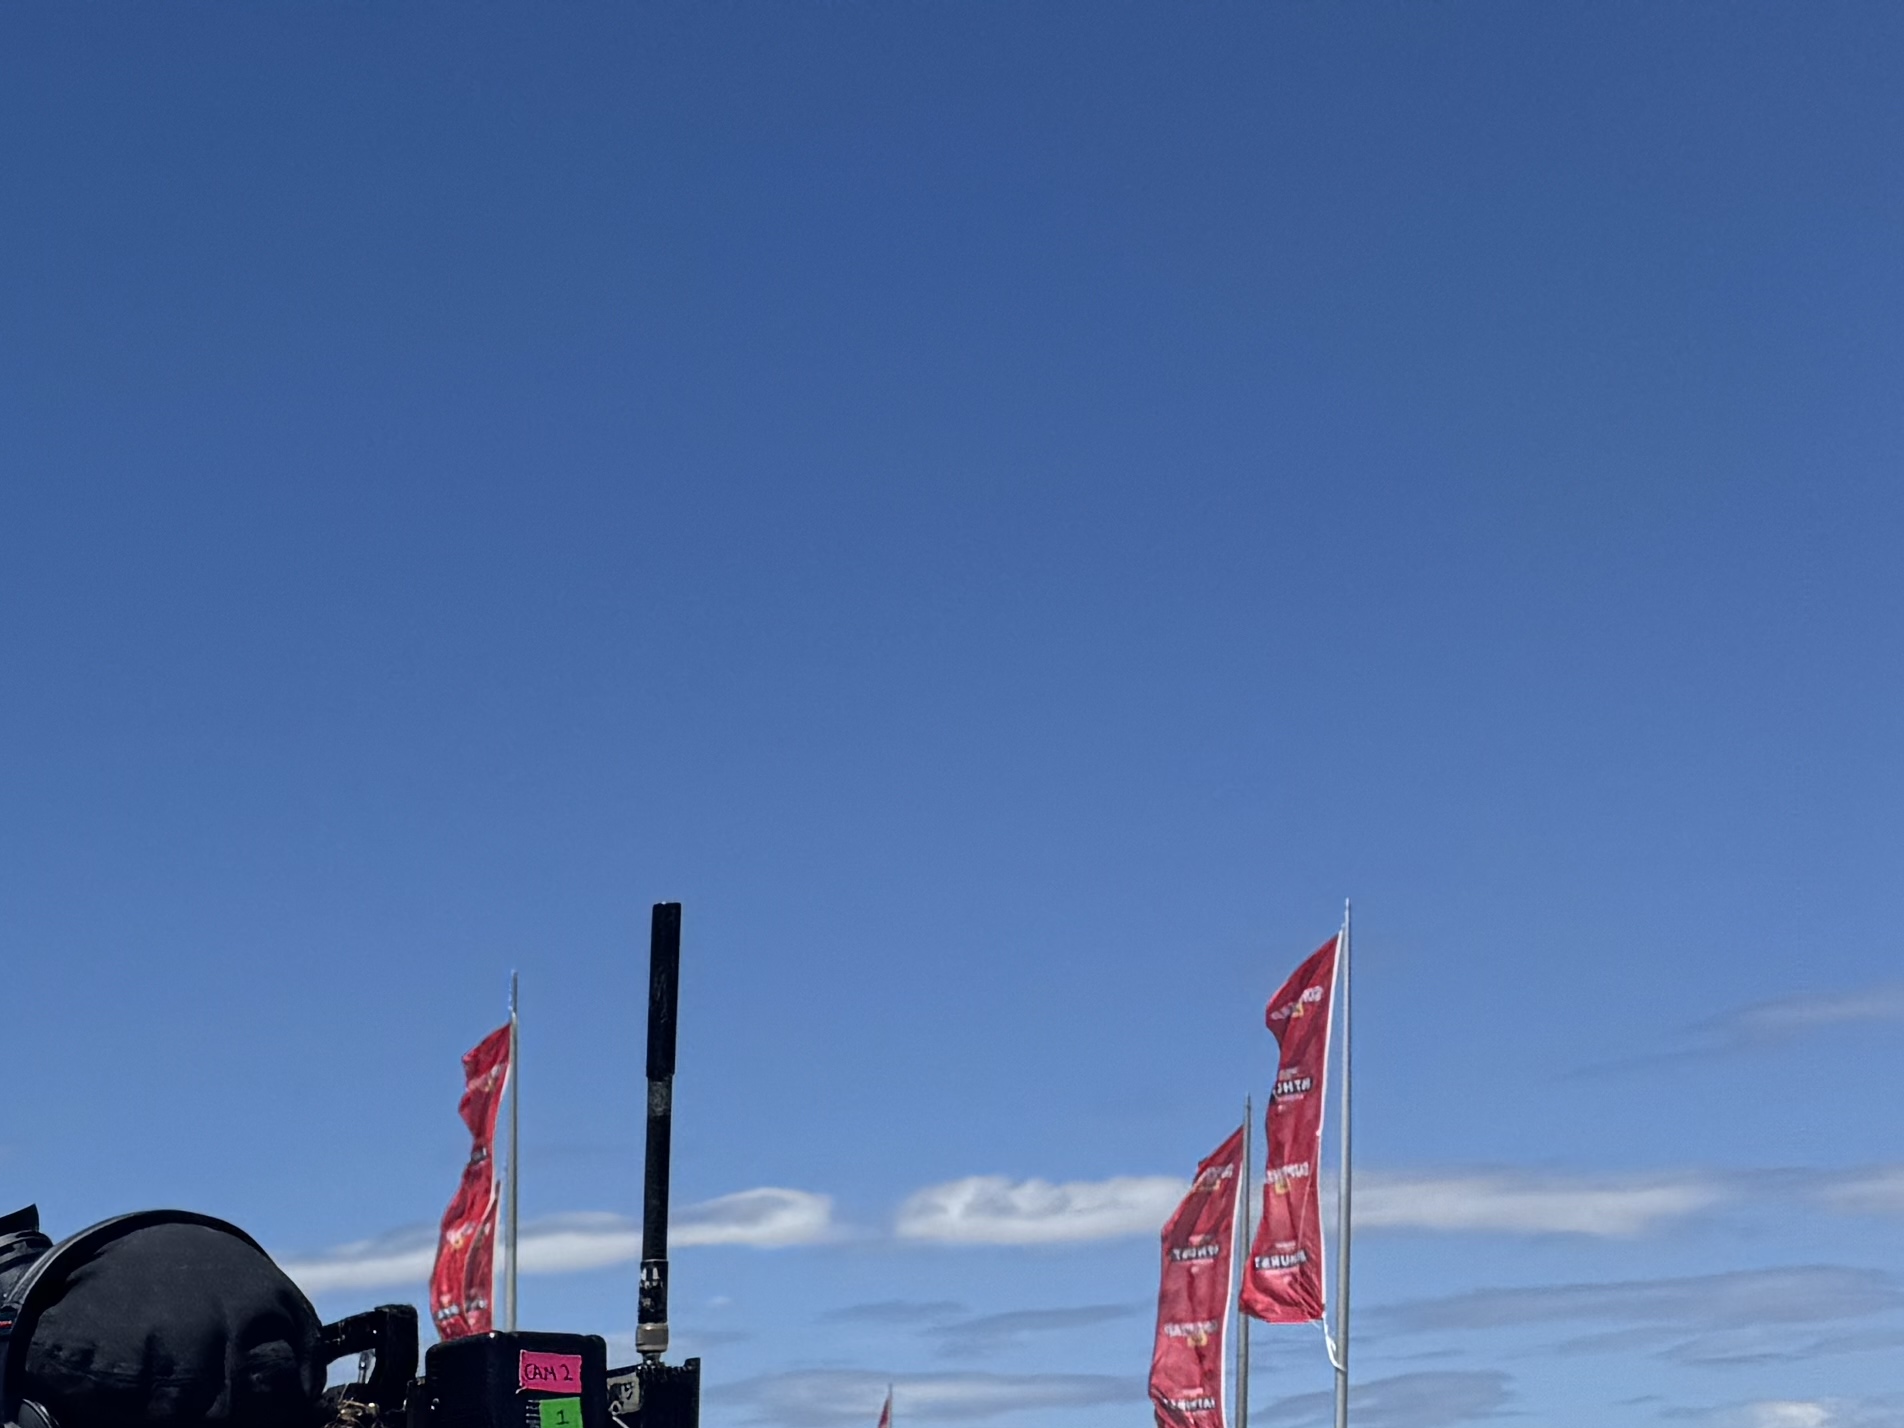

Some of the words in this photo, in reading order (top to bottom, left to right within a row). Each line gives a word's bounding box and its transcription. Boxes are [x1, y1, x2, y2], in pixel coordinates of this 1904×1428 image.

[524, 1363, 557, 1382] CAM
[560, 1363, 574, 1382] 2
[556, 1409, 570, 1426] 1
